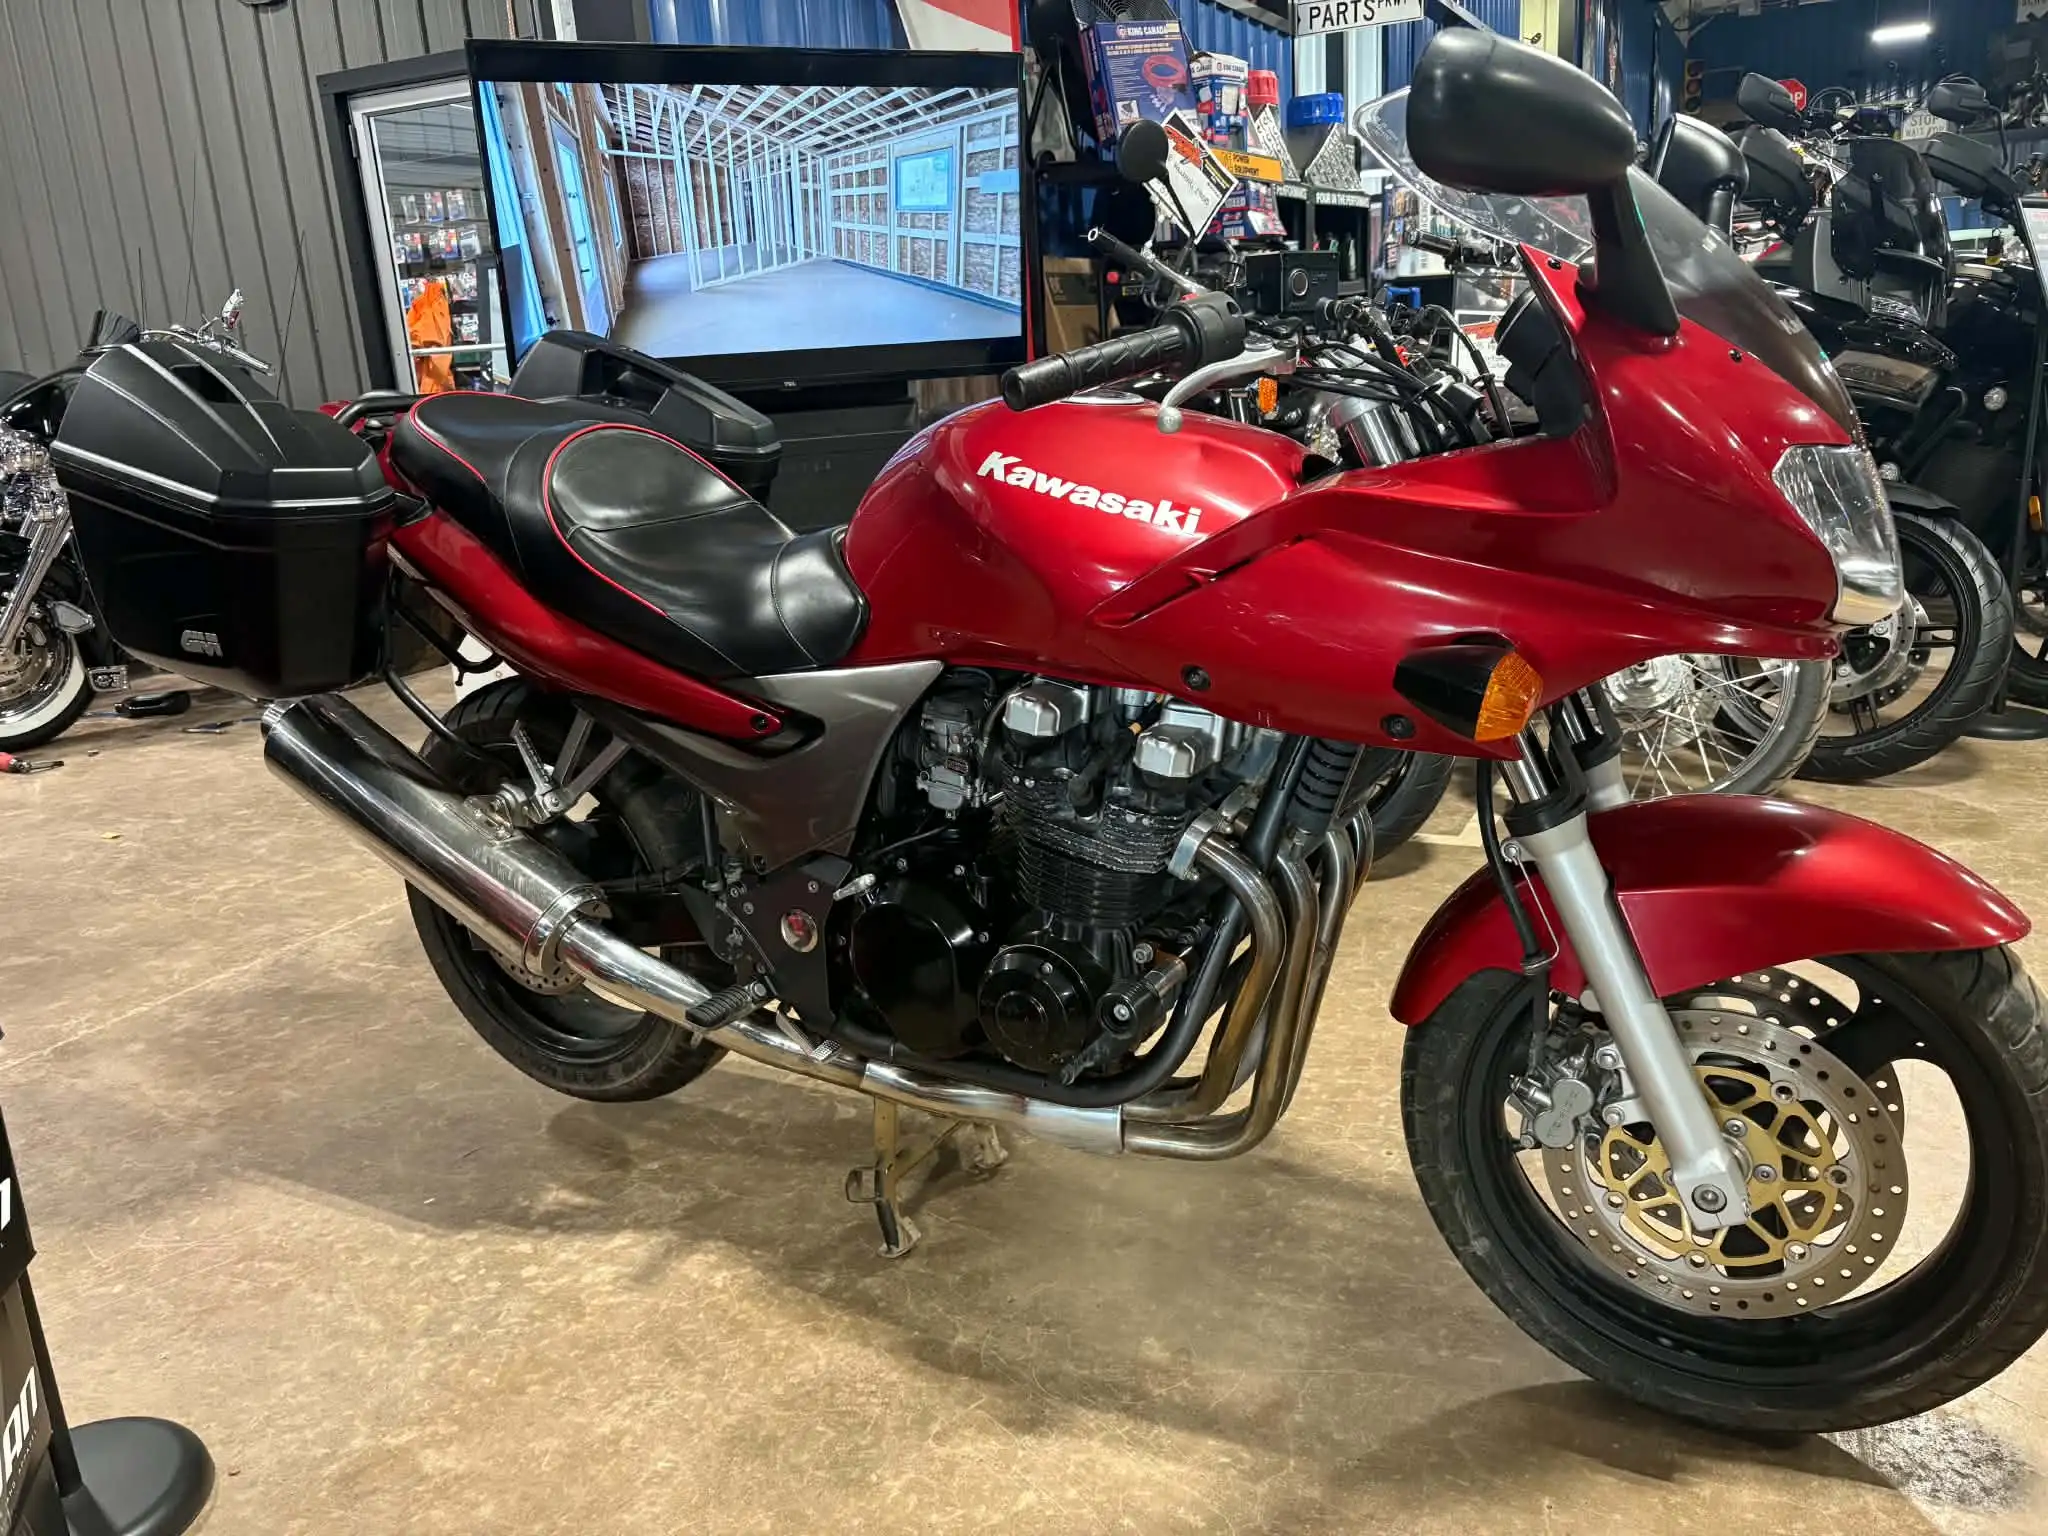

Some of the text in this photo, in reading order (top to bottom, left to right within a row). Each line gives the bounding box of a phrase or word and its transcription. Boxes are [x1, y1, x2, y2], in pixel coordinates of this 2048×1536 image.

[1308, 0, 1375, 29] PARTS
[1127, 27, 1143, 36] KING
[977, 450, 1202, 537] Kawasaki
